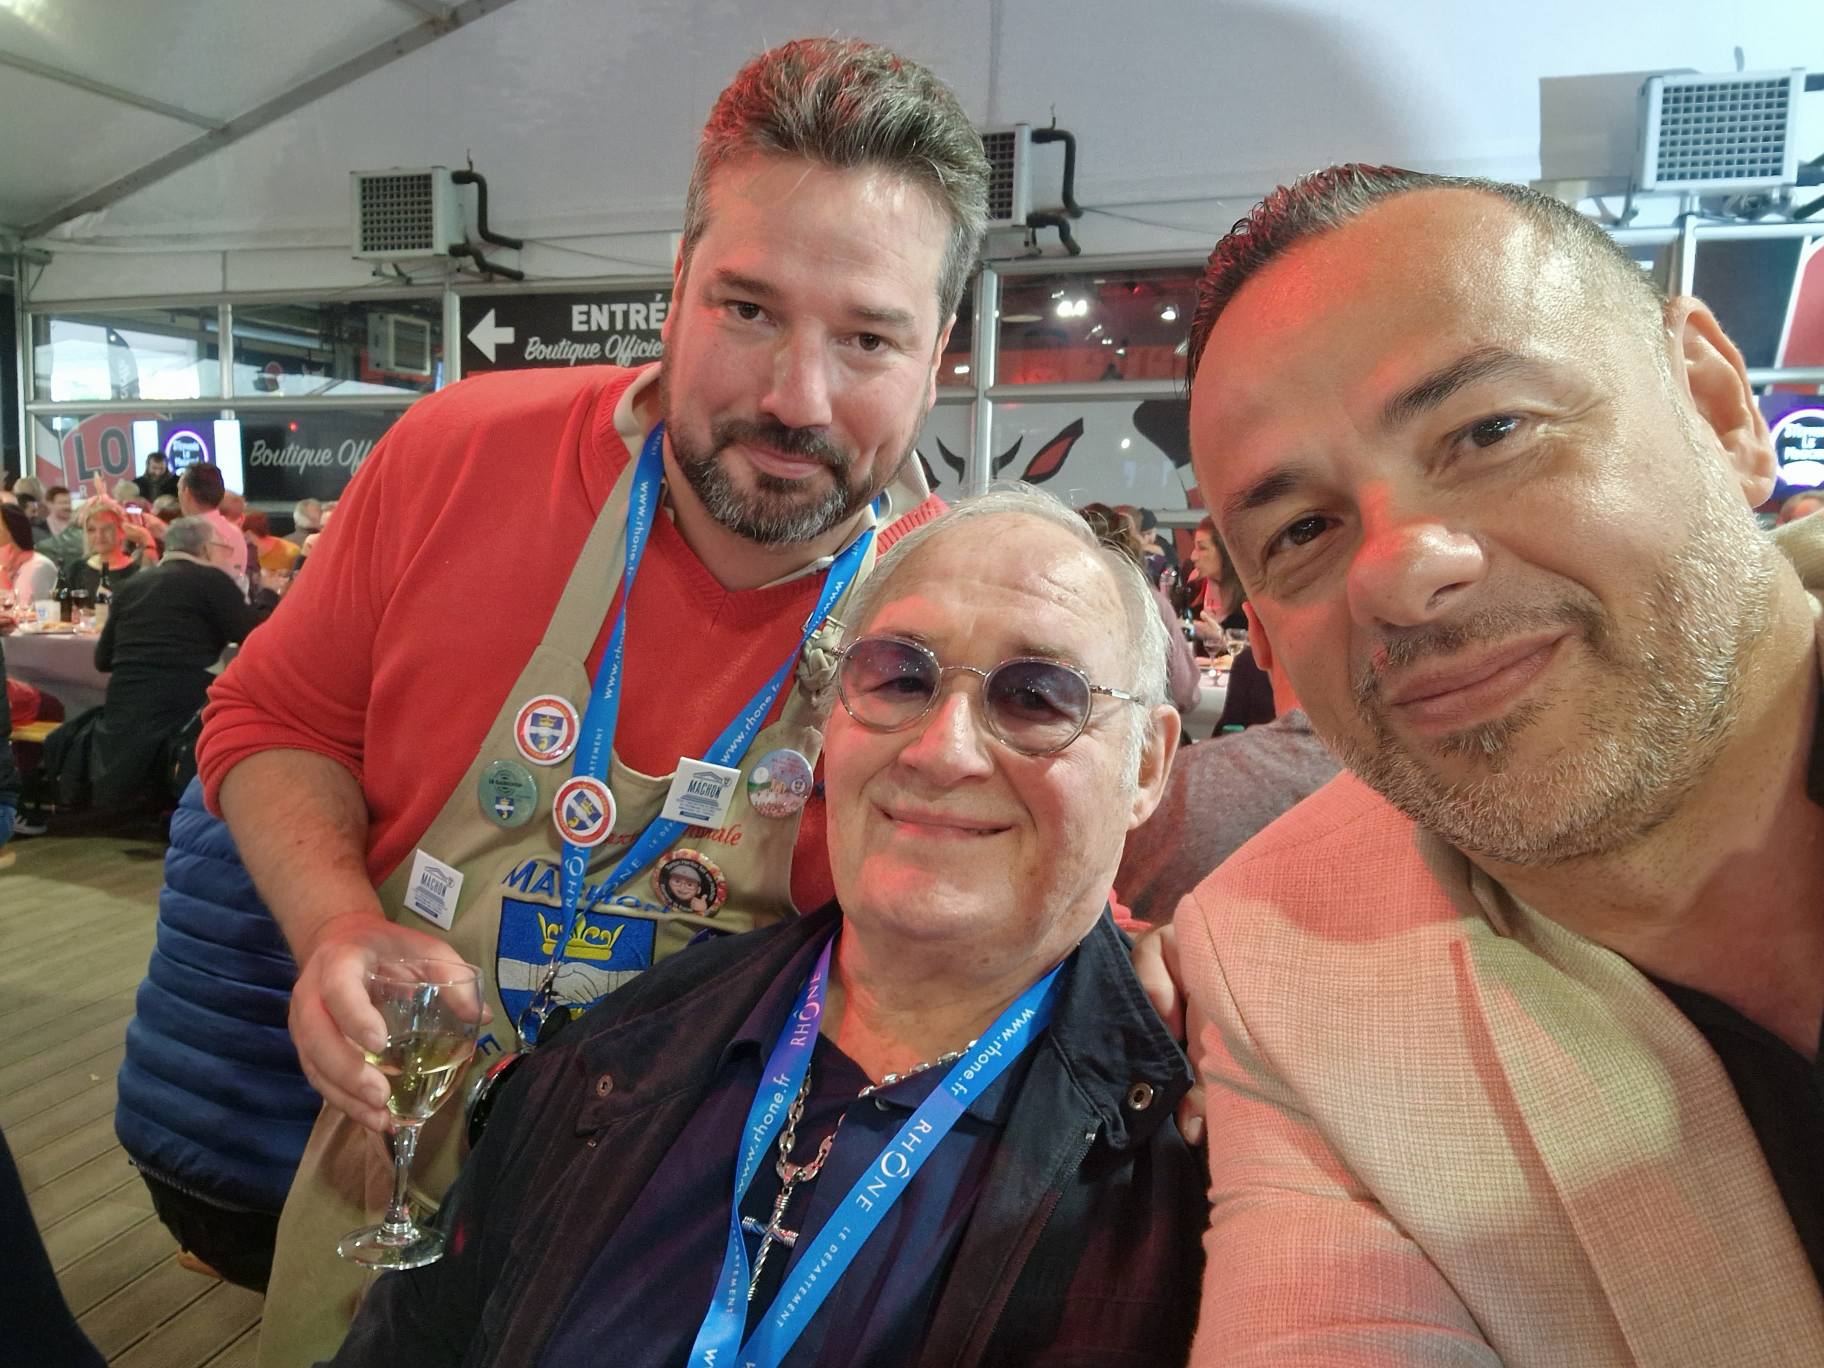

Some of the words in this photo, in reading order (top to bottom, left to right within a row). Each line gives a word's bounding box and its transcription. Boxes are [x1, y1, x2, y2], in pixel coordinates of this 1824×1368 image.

[571, 293, 673, 332] ENTRÉ
[524, 336, 601, 367] Boutique
[605, 334, 665, 367] Officie
[250, 439, 334, 475] Boutique
[338, 439, 374, 476] Off
[627, 481, 649, 576] www.rhone.fr
[950, 1008, 1036, 1096] www.rhone.fr
[736, 1073, 791, 1193] www.rhone.fr
[855, 1118, 933, 1213] RHÔNE
[837, 1226, 851, 1241] LE
